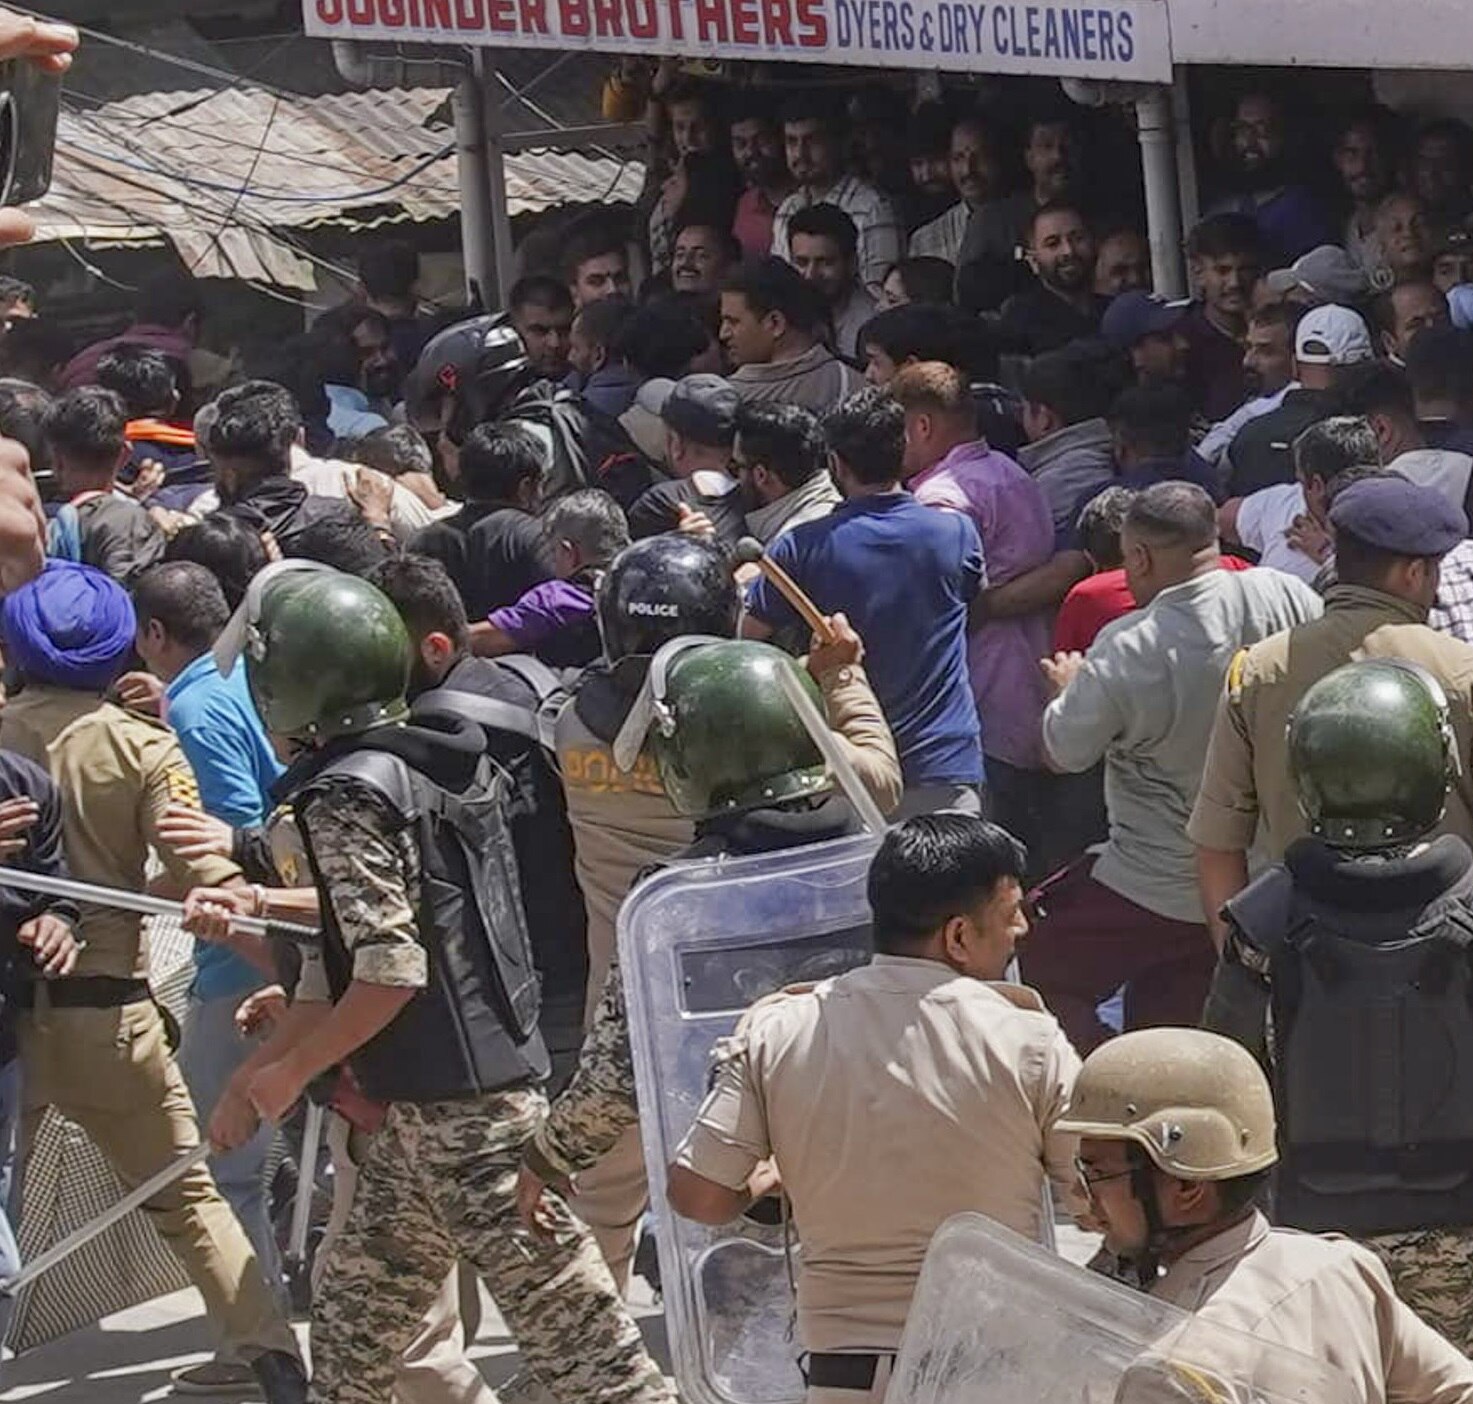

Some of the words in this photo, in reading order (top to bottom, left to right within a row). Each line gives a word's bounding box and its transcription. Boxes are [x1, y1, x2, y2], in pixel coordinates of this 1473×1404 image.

[560, 0, 828, 47] BROTHERS
[837, 0, 914, 51] DYERS
[920, 12, 935, 51] &
[939, 3, 986, 54] DRY
[993, 6, 1134, 62] CLEANERS
[628, 602, 678, 617] POLICE
